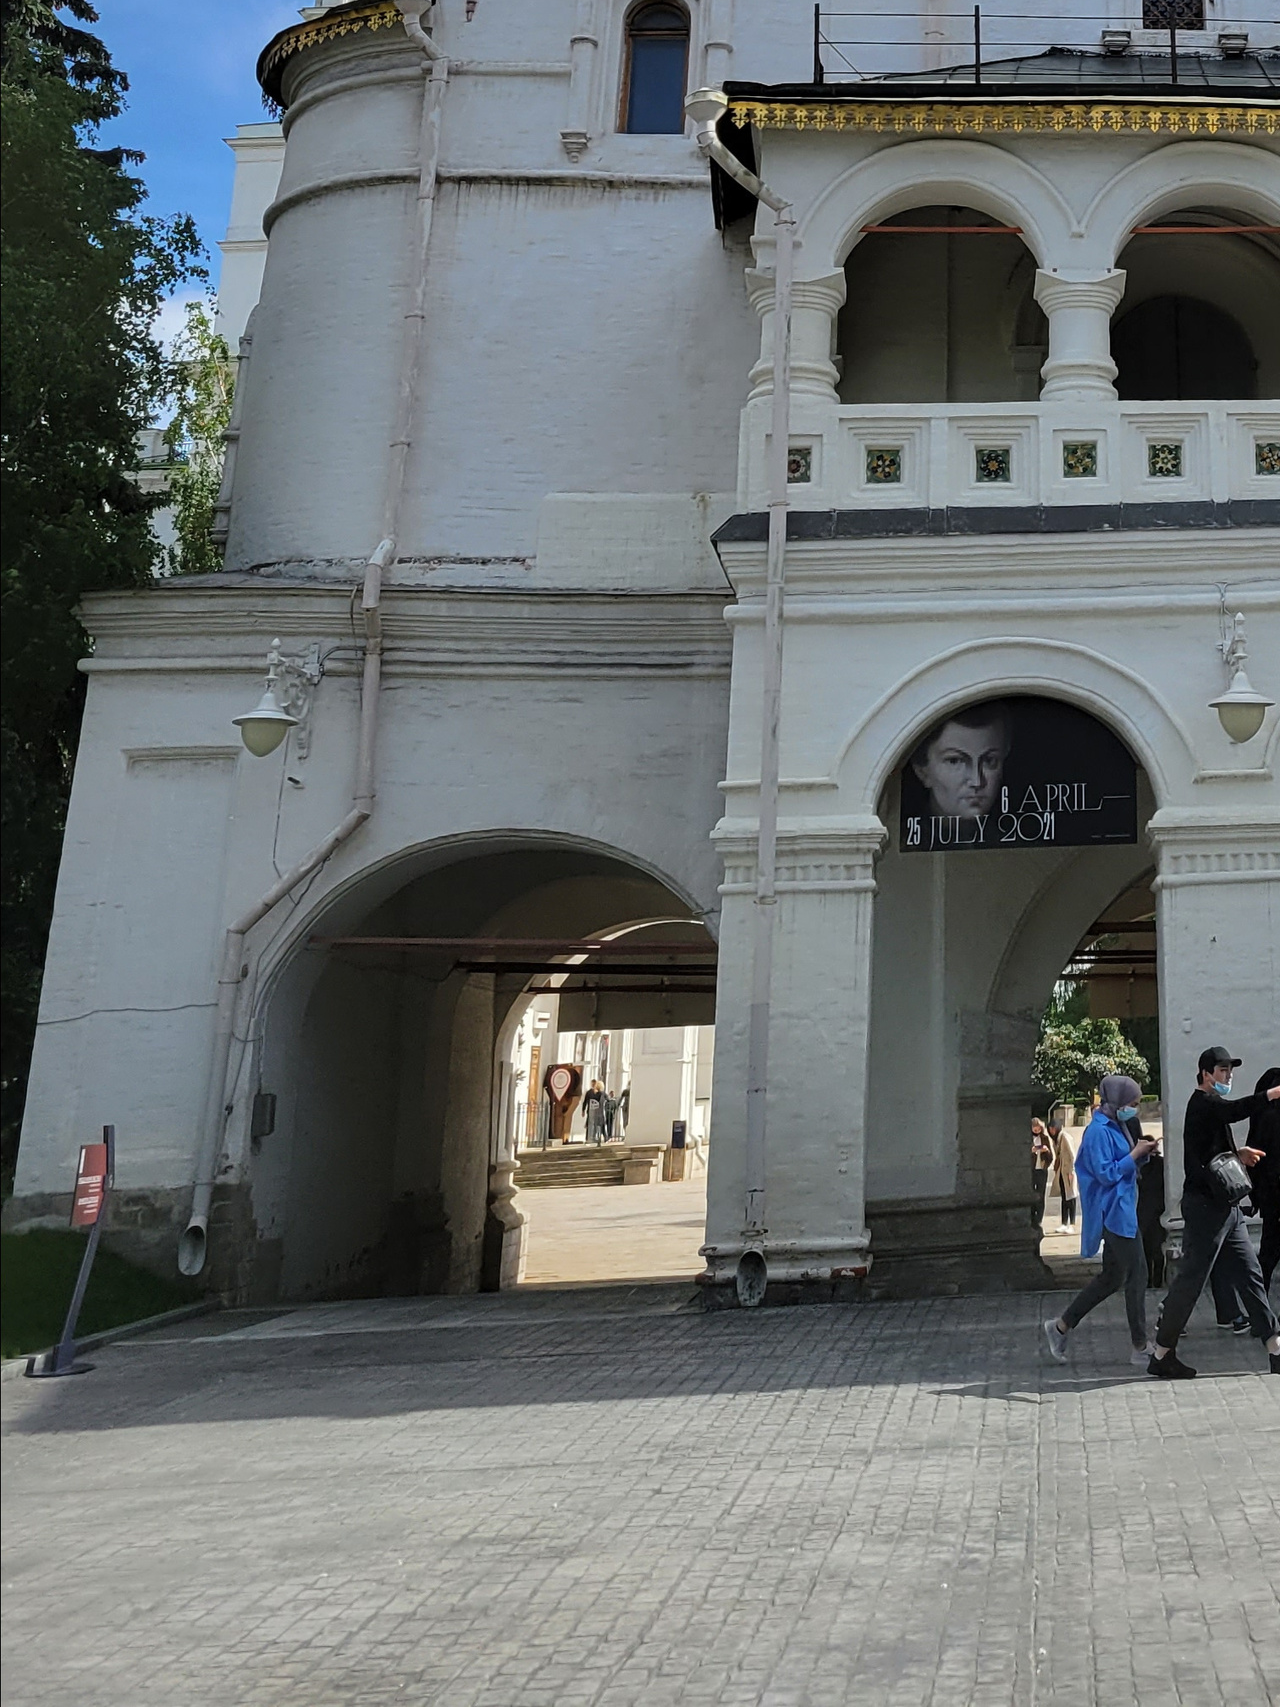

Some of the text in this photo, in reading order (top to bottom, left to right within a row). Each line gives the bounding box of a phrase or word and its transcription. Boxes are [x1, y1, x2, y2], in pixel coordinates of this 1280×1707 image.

[1001, 785, 1009, 814] 6
[907, 811, 1055, 851] 25 JULY 2021
